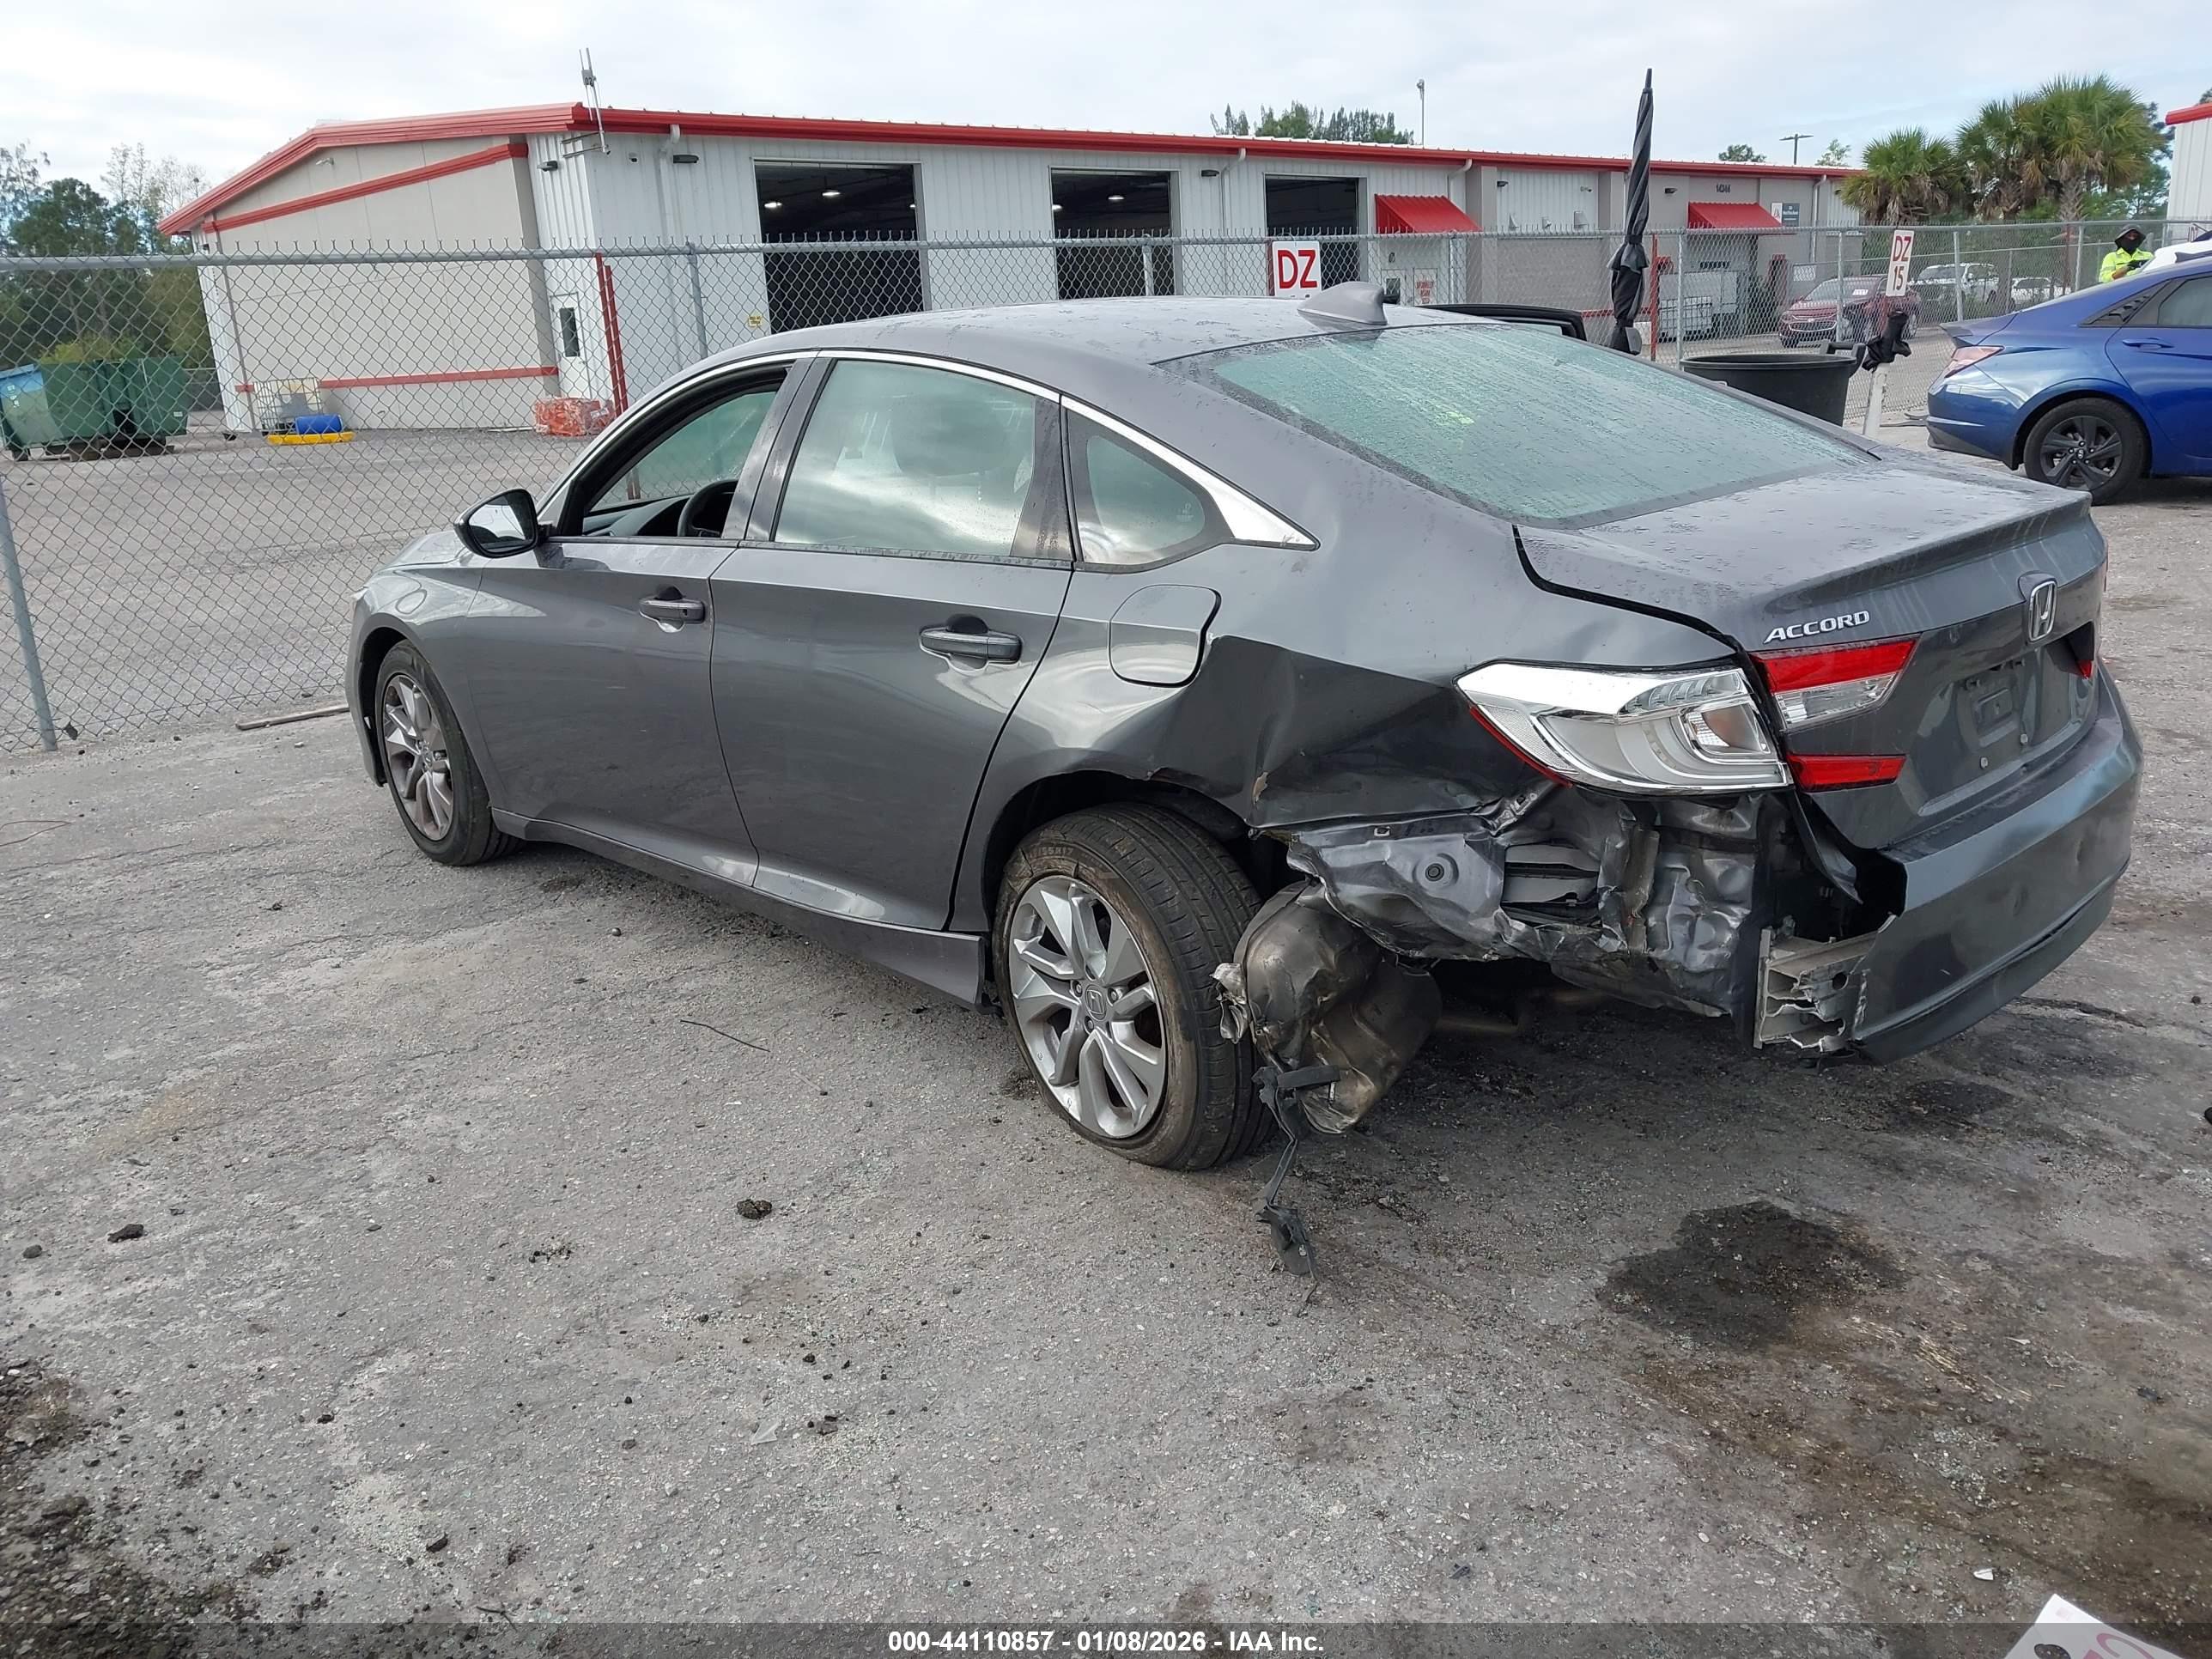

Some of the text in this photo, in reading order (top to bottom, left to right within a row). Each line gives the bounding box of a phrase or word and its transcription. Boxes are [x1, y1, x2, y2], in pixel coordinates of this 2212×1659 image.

[1893, 235, 1911, 262] DZ
[1277, 249, 1318, 289] DZ
[1893, 265, 1905, 291] 15
[1763, 611, 1870, 644] ACCORD
